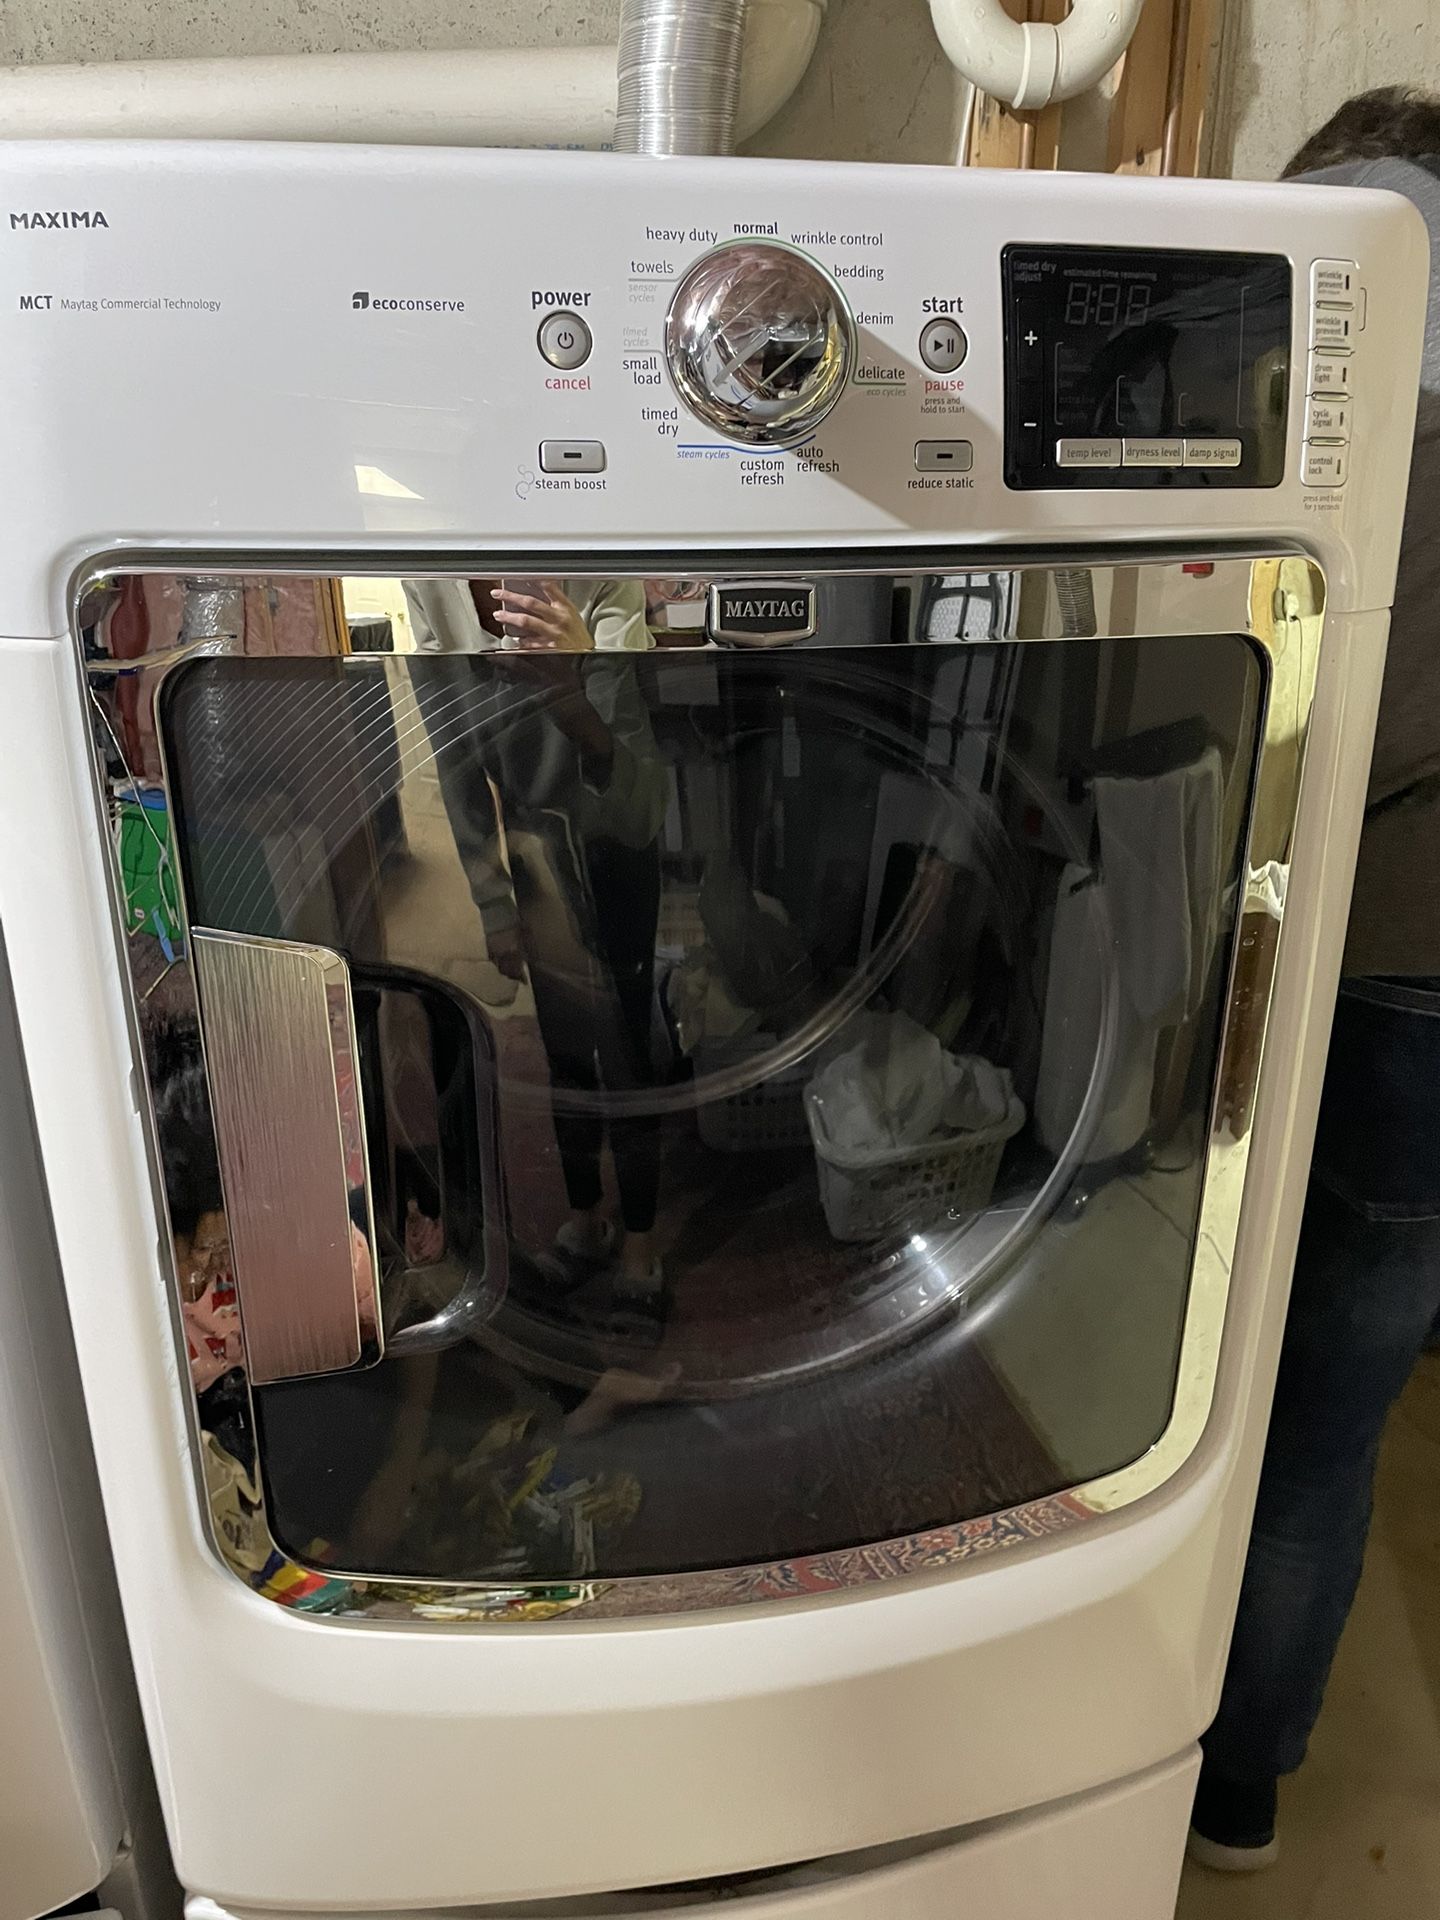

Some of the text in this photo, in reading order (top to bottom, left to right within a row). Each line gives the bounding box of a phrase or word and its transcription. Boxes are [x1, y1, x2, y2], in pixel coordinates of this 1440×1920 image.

[10, 211, 109, 229] MAXIMA
[733, 222, 778, 235] normal
[646, 226, 718, 245] heavy duty
[791, 232, 883, 246] wrinkle control
[631, 260, 674, 273] towels
[1041, 261, 1057, 273] dry
[834, 265, 884, 281] bedding
[1317, 270, 1342, 280] wrinkle
[628, 283, 657, 292] sensor
[1317, 281, 1343, 290] prevent
[20, 296, 221, 312] MCT Maytag Commercial Technology
[531, 291, 591, 309] power
[629, 293, 655, 303] cycles
[373, 299, 465, 312] ecoconserve
[922, 297, 963, 313] start
[856, 313, 893, 325] denim
[622, 326, 647, 336] timed
[623, 336, 649, 347] cycles
[622, 357, 657, 369] small
[634, 372, 661, 384] load
[858, 366, 905, 379] delicate
[1314, 373, 1330, 384] light
[545, 376, 591, 390] cancel
[925, 380, 964, 394] pause
[866, 388, 906, 398] eco cycles
[924, 397, 961, 406] press and
[642, 407, 678, 420] timed
[920, 405, 965, 413] hold to start
[1312, 409, 1330, 419] cycle
[1312, 418, 1332, 428] signal
[658, 423, 678, 437] dry
[677, 450, 730, 460] steam cycles
[796, 446, 823, 458] auto
[1066, 448, 1112, 459] temp level
[1126, 447, 1181, 458] dryness level
[1189, 448, 1238, 459] damp signal
[740, 459, 784, 471] custom
[797, 459, 840, 472] refresh
[1309, 457, 1333, 466] control
[1308, 466, 1322, 475] lock
[535, 478, 607, 490] steam boost
[741, 472, 784, 485] refresh
[908, 476, 974, 489] reduce static
[725, 600, 805, 617] MAYTAG
